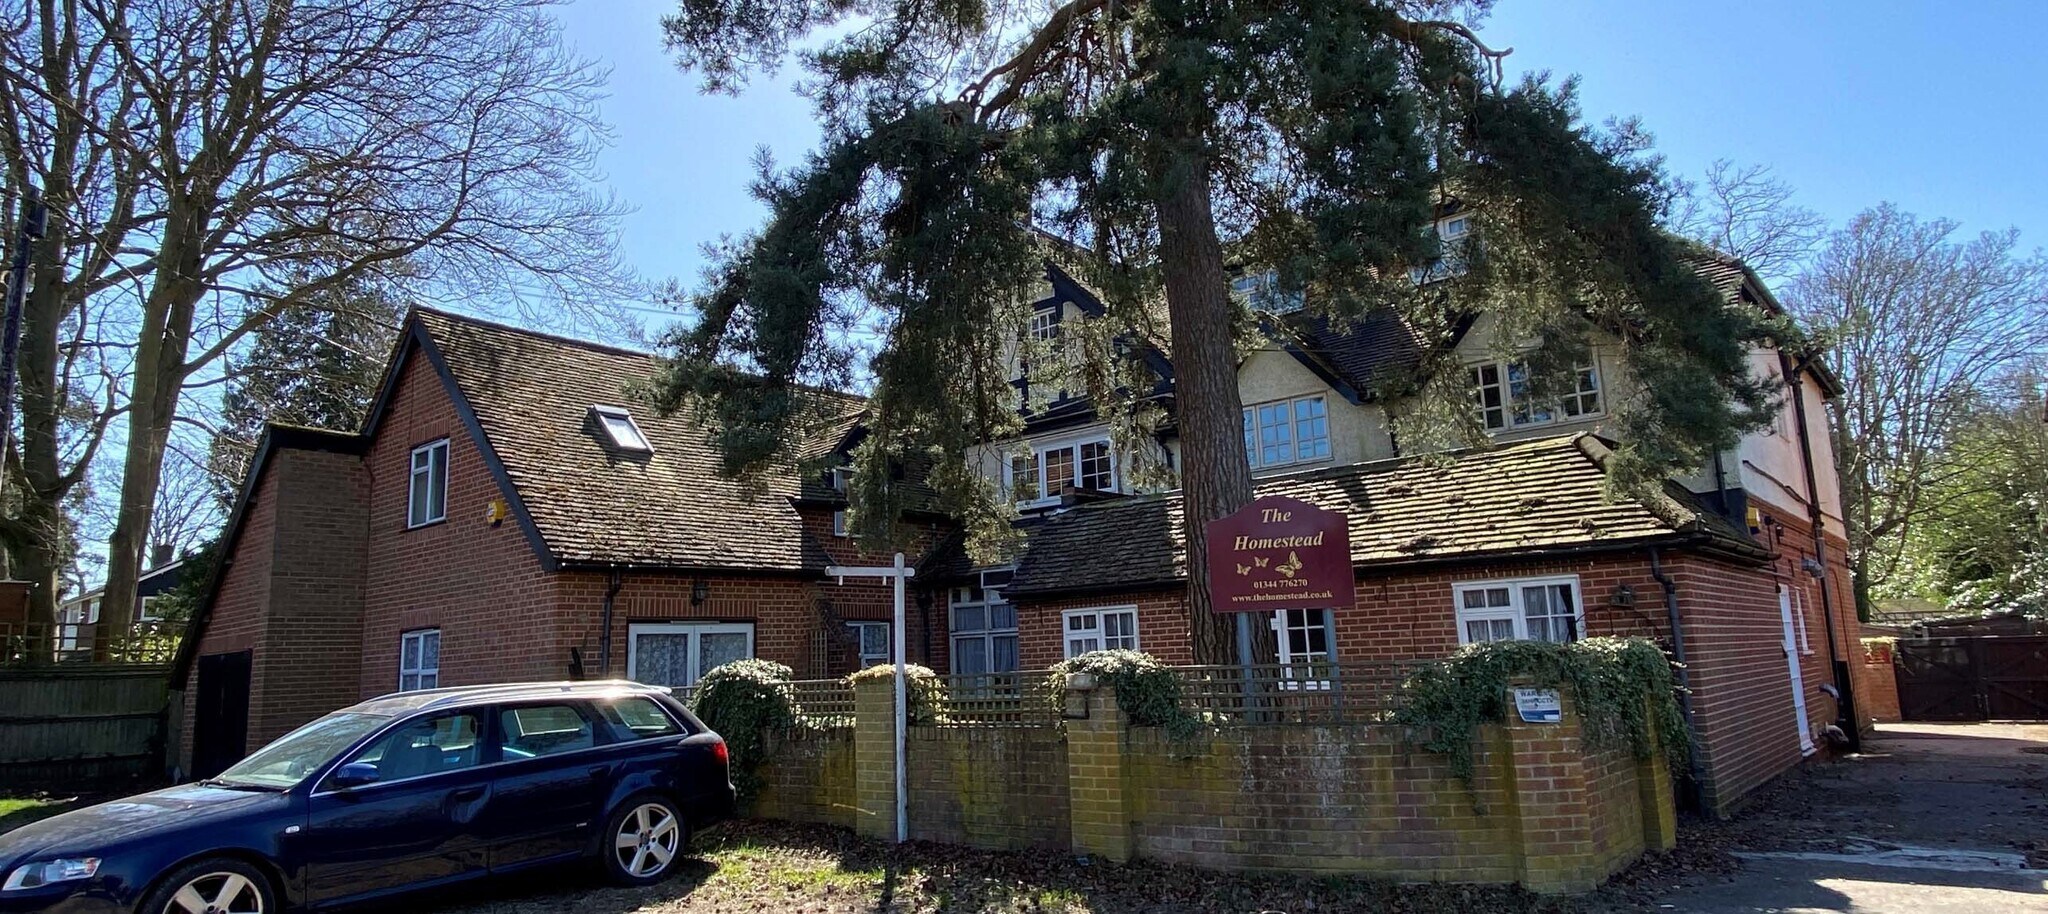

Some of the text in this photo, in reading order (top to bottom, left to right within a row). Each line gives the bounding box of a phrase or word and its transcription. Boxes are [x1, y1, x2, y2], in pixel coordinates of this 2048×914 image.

[1261, 508, 1292, 524] The
[1233, 531, 1324, 551] Homestead
[1253, 579, 1308, 589] 01344 776270
[1232, 590, 1333, 602] www.thehomestead.co.uk
